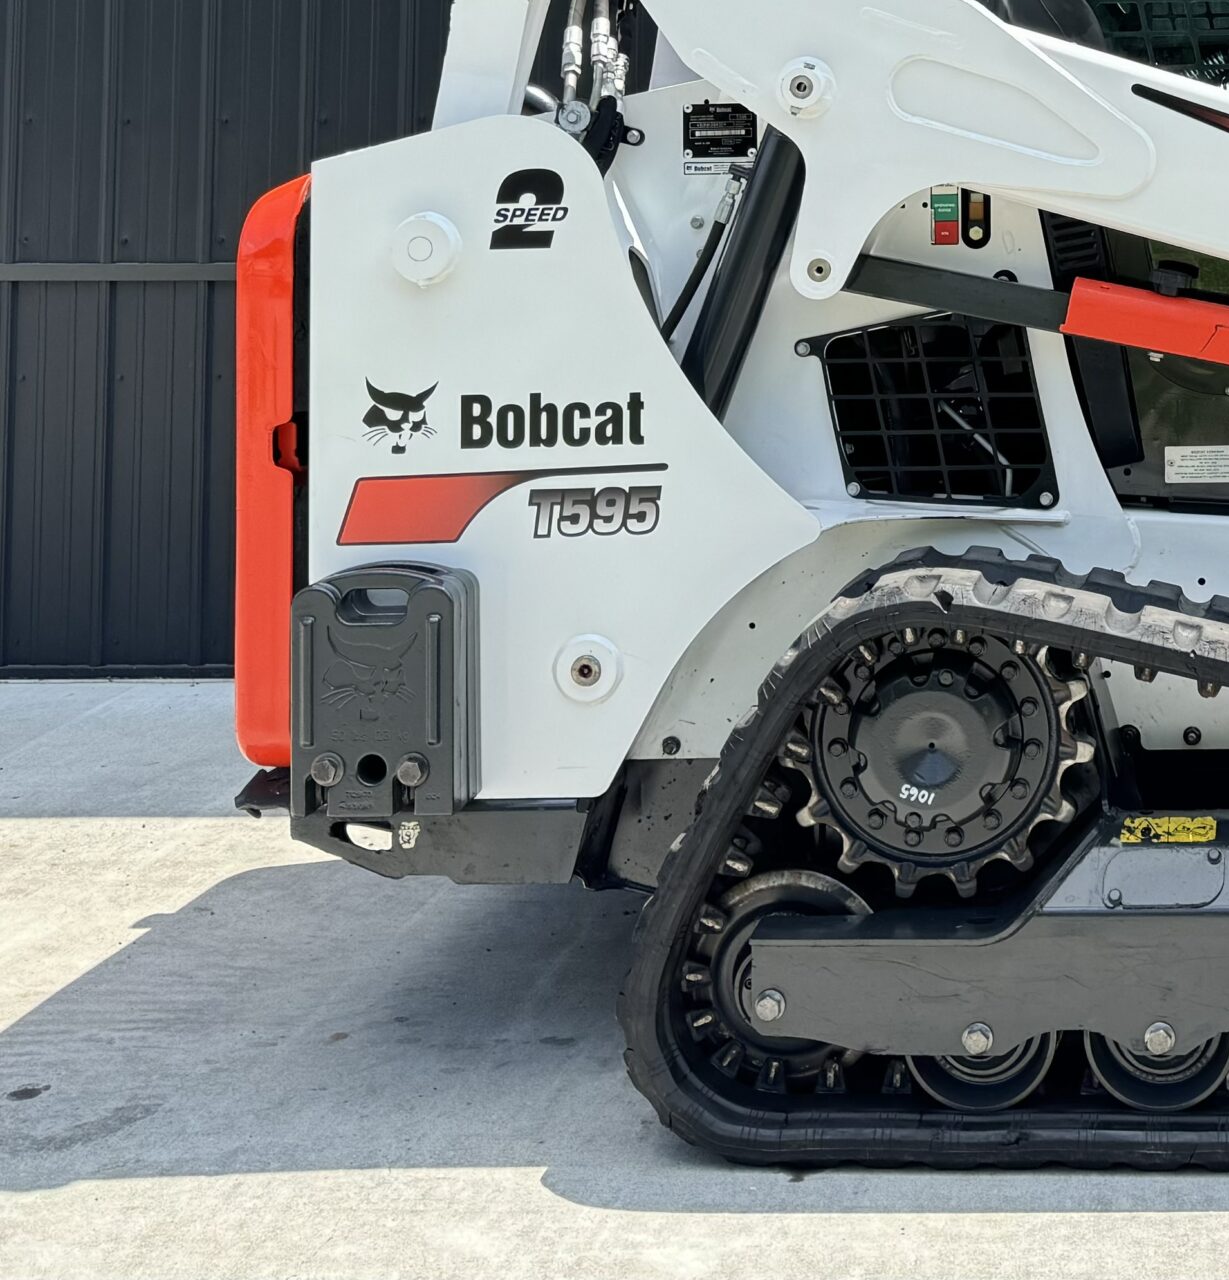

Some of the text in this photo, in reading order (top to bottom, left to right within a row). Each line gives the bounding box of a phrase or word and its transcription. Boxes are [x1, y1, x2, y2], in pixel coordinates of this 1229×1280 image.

[489, 167, 565, 250] 2
[493, 206, 569, 224] SPEED
[460, 391, 645, 449] Bobcat
[528, 485, 662, 539] T595
